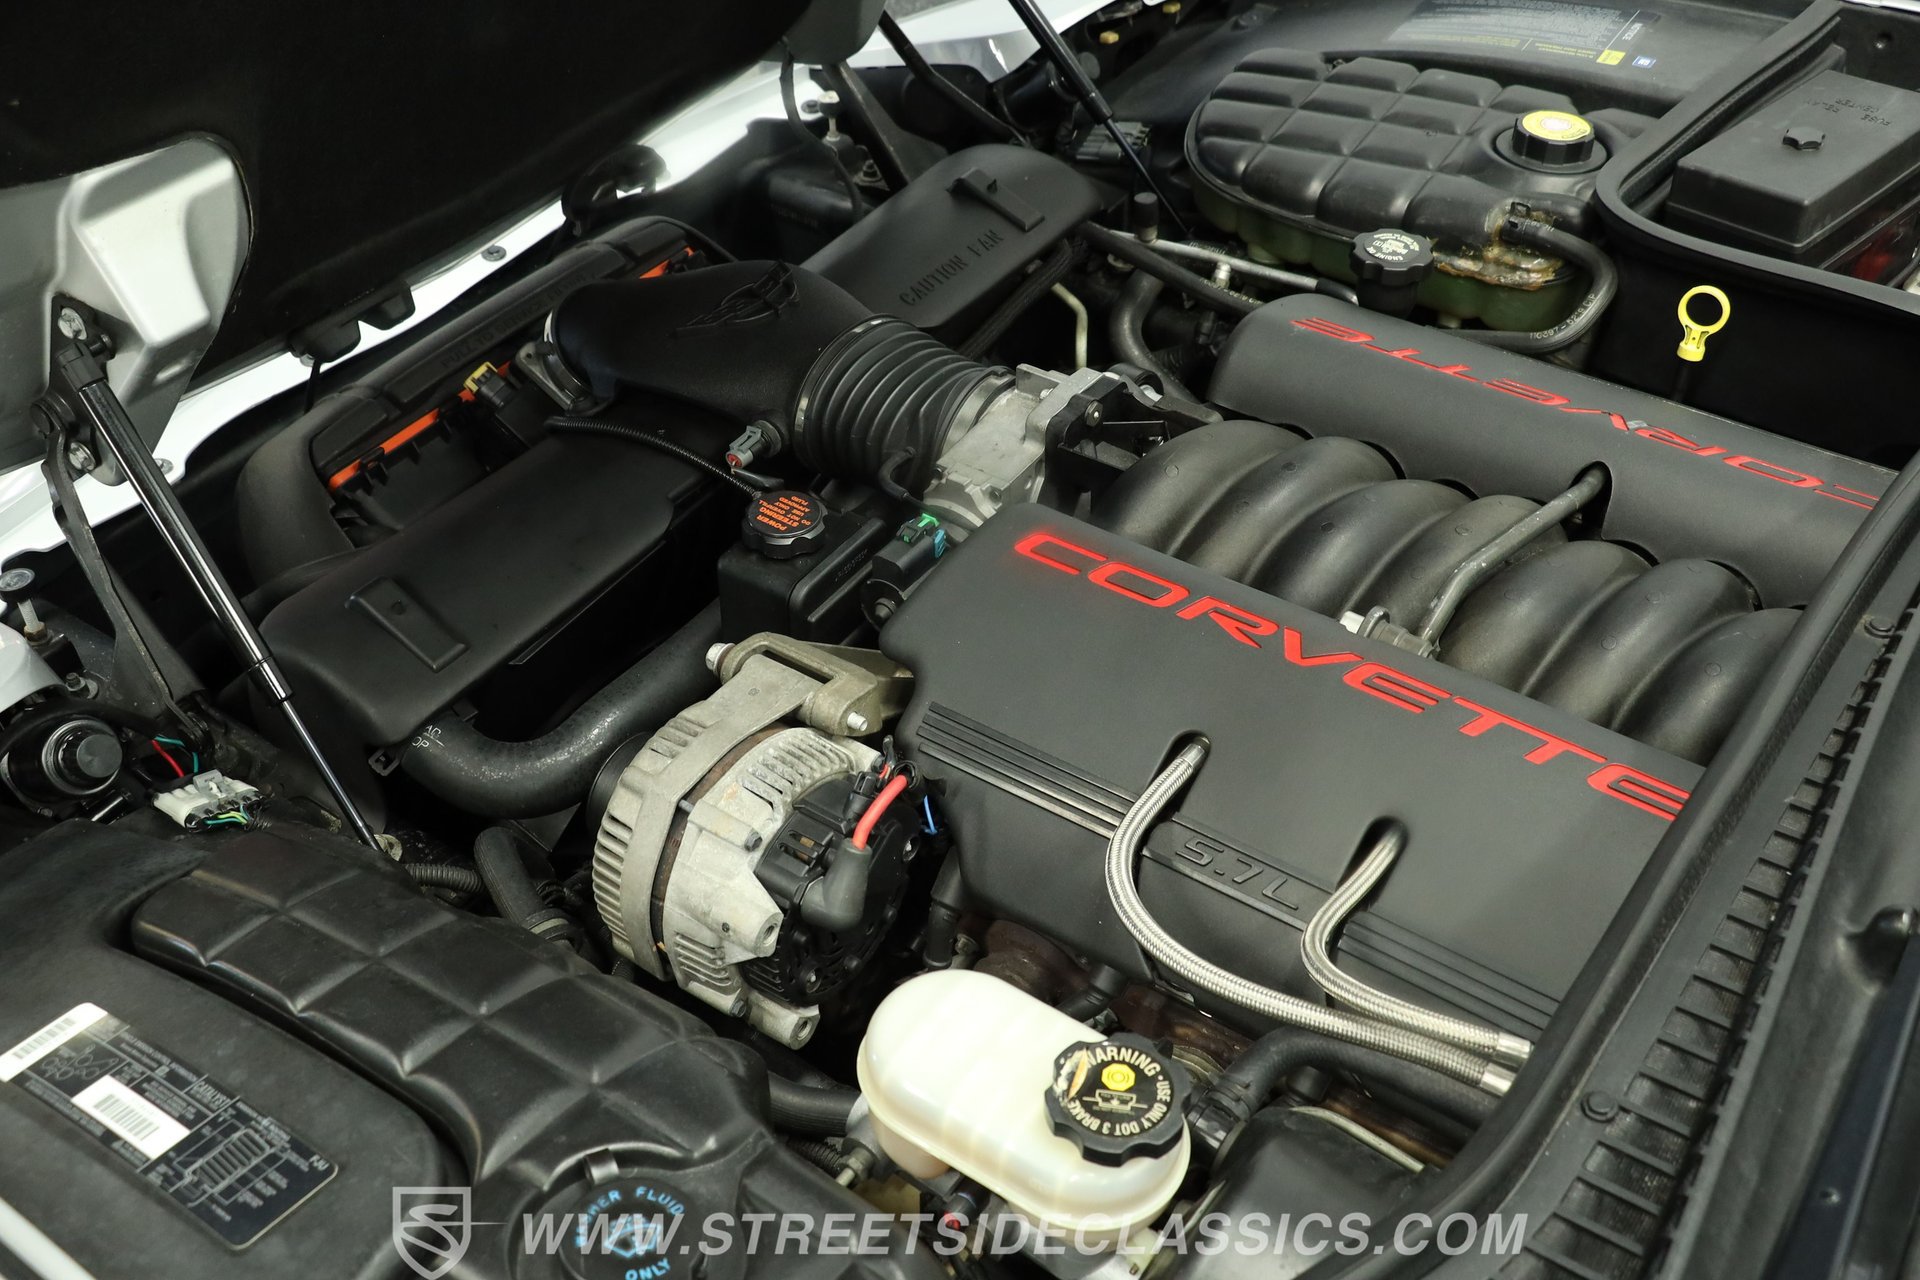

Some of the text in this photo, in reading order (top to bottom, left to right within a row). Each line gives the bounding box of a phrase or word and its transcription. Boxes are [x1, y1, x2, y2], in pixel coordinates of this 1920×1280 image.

[899, 229, 1005, 306] CAUTION FAN
[779, 496, 810, 512] APPROVED
[791, 495, 809, 506] FLUID
[756, 514, 787, 531] POWER
[759, 506, 799, 527] STEERING
[787, 513, 800, 521] NOT
[1013, 532, 1691, 822] CORVETTE
[1175, 836, 1299, 911] 5.7L
[1156, 1081, 1171, 1103] USE
[1140, 1102, 1168, 1129] ONLY
[1102, 1121, 1111, 1135] 3
[1114, 1121, 1140, 1136] DOT
[635, 1186, 685, 1216] FLUID
[625, 1257, 671, 1280] ONLY
